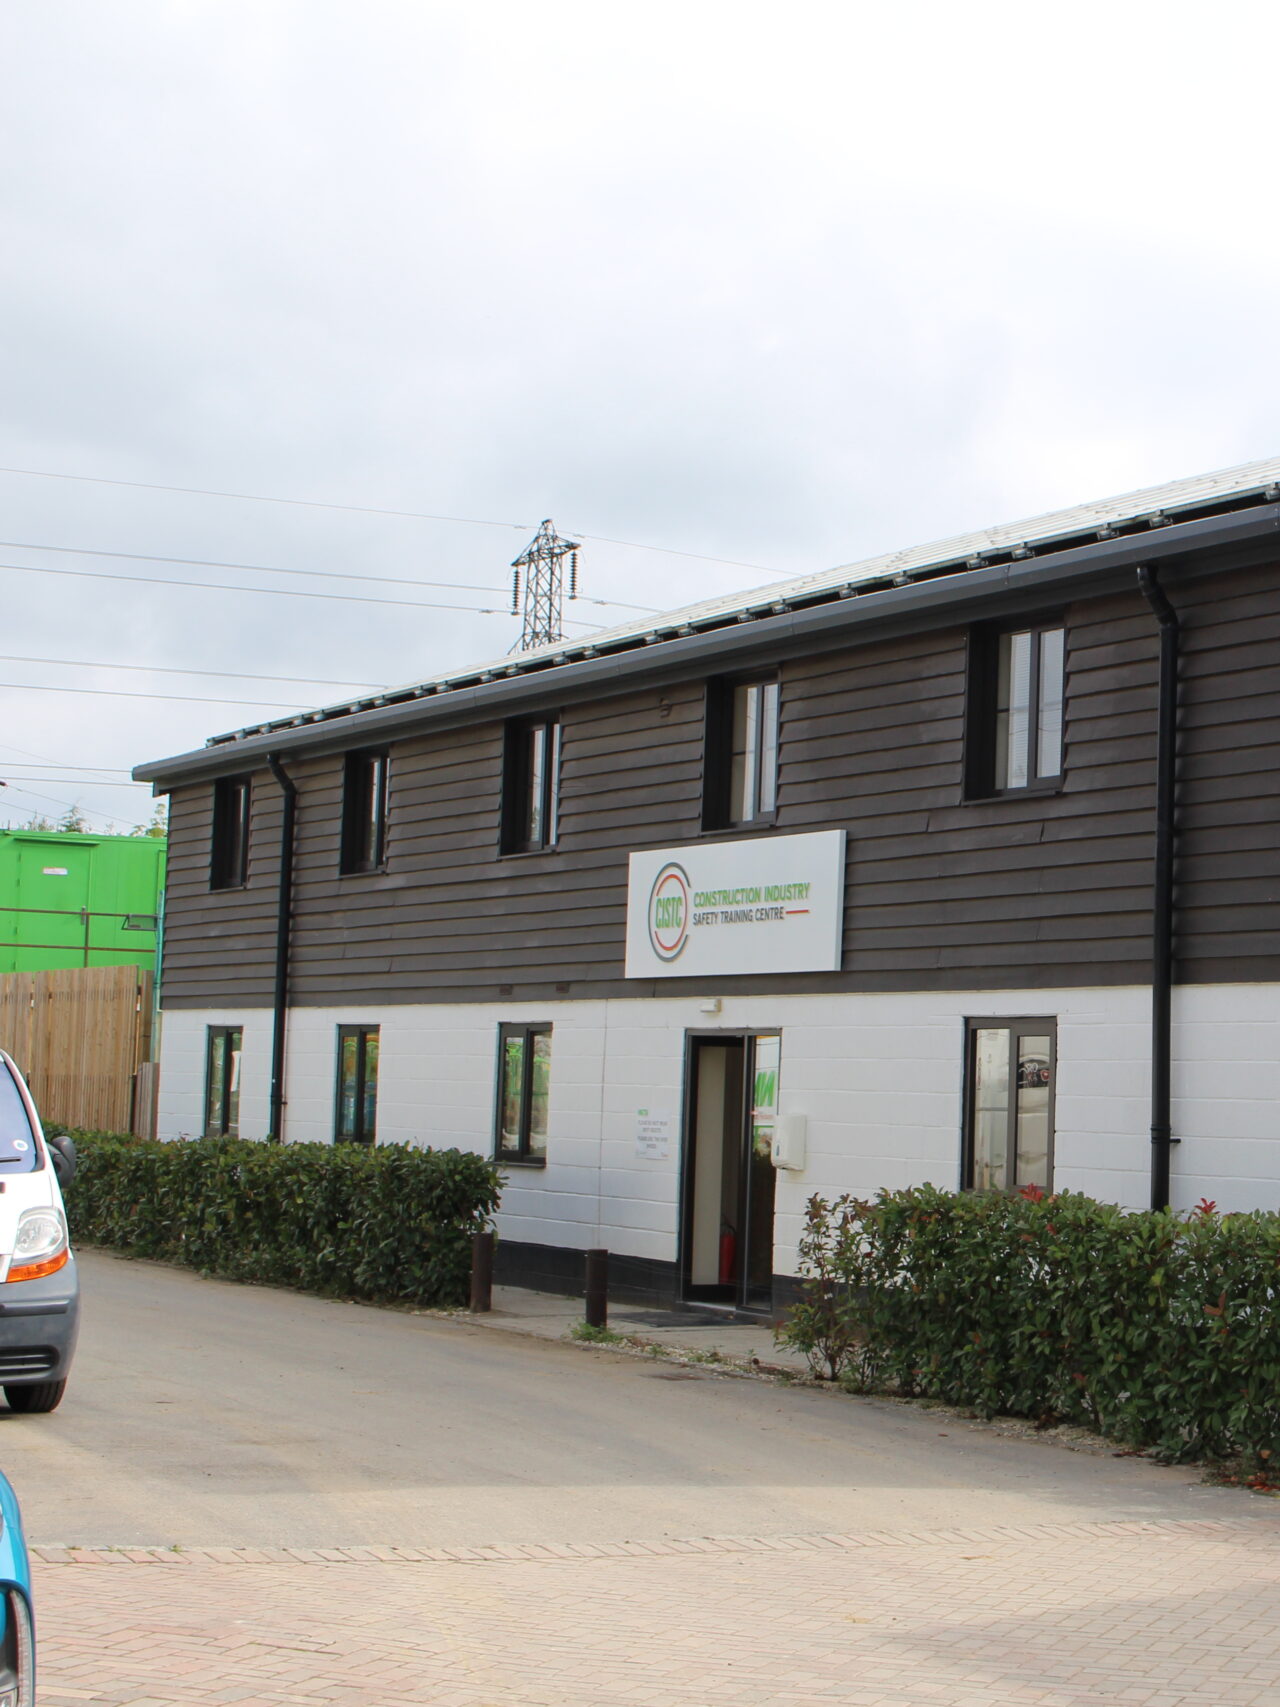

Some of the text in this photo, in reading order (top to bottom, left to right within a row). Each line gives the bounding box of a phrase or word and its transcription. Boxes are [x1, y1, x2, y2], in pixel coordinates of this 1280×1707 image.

[693, 882, 810, 908] CONSTRUCTION INDUSTRY
[655, 896, 683, 928] CISTC
[693, 906, 785, 926] SAFETY TRAINING CENTRE
